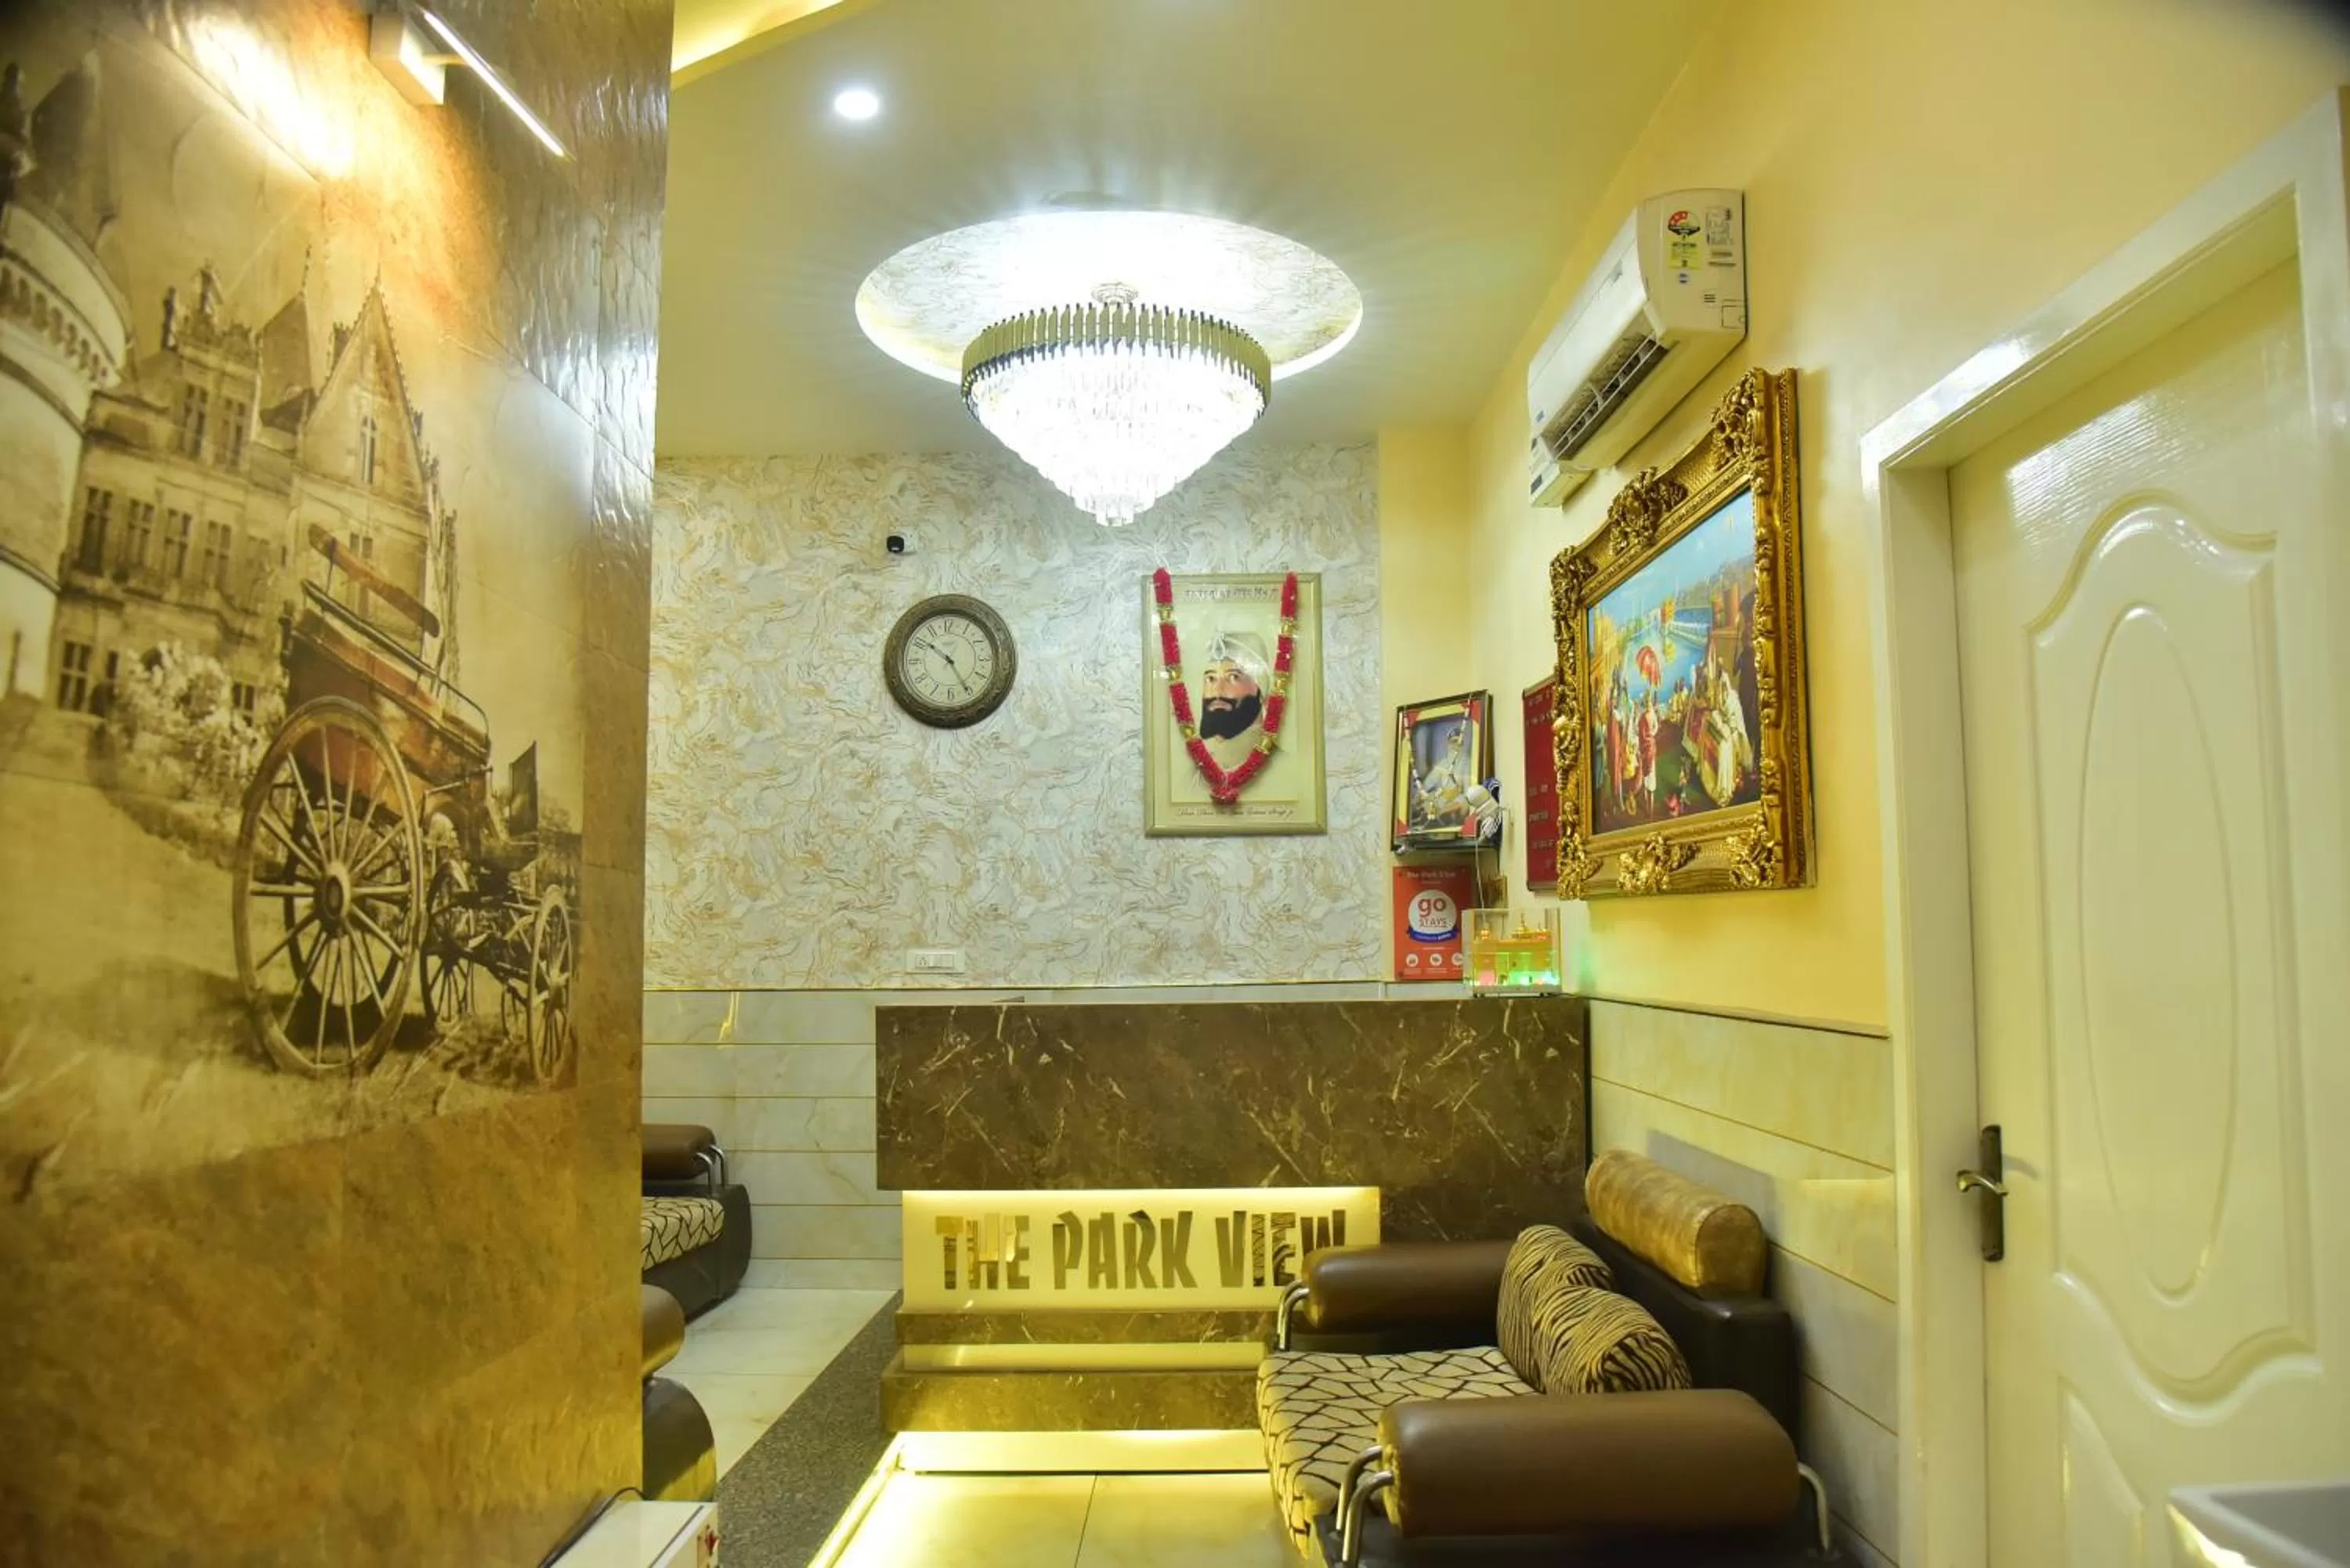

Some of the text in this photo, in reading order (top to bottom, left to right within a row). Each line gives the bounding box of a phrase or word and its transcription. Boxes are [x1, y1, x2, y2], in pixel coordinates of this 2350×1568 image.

[1418, 898, 1447, 917] go
[935, 1212, 1030, 1290] THE
[1052, 1210, 1198, 1290] PARK
